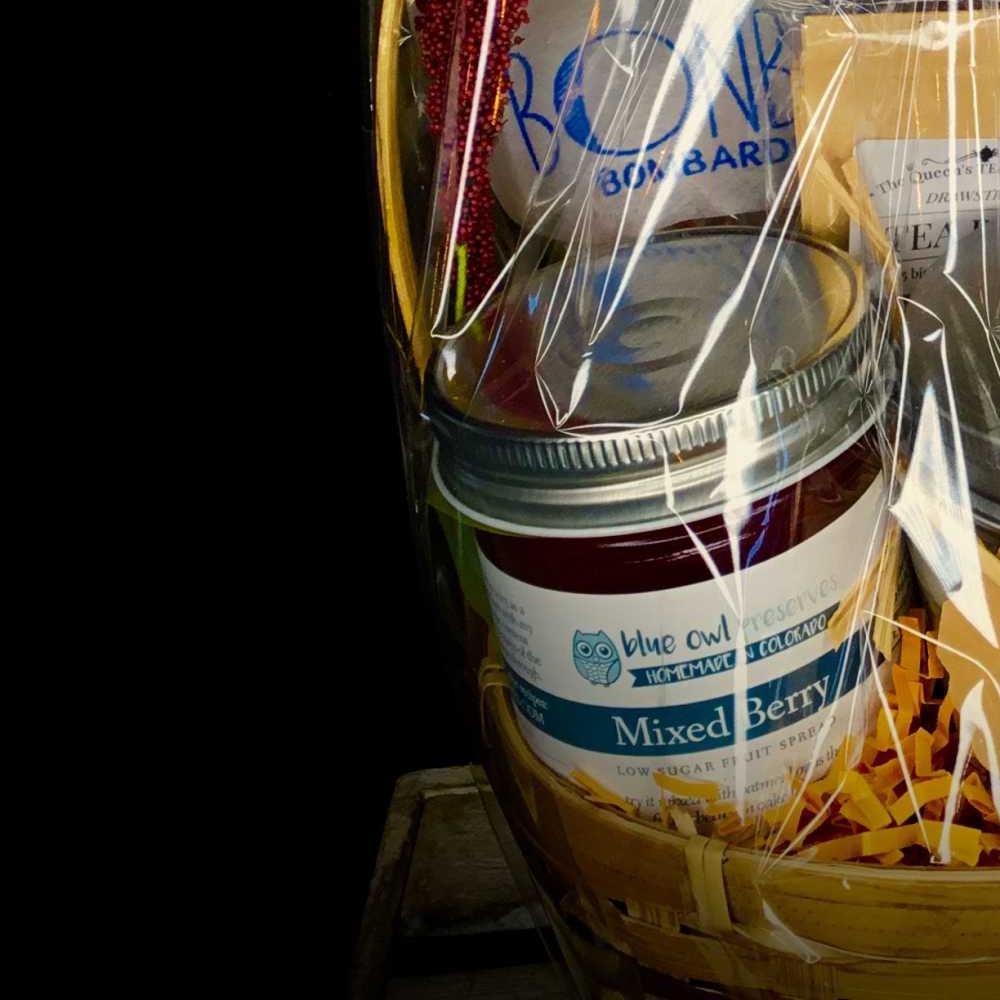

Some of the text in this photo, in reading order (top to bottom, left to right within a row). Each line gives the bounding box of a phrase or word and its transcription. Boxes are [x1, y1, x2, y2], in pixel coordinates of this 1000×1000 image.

[620, 628, 677, 659] blue
[686, 612, 732, 650] owl
[646, 652, 734, 685] HOMEMADE
[759, 613, 827, 658] COLORADO
[611, 675, 831, 748] Mixed Berry
[616, 764, 650, 777] LOW
